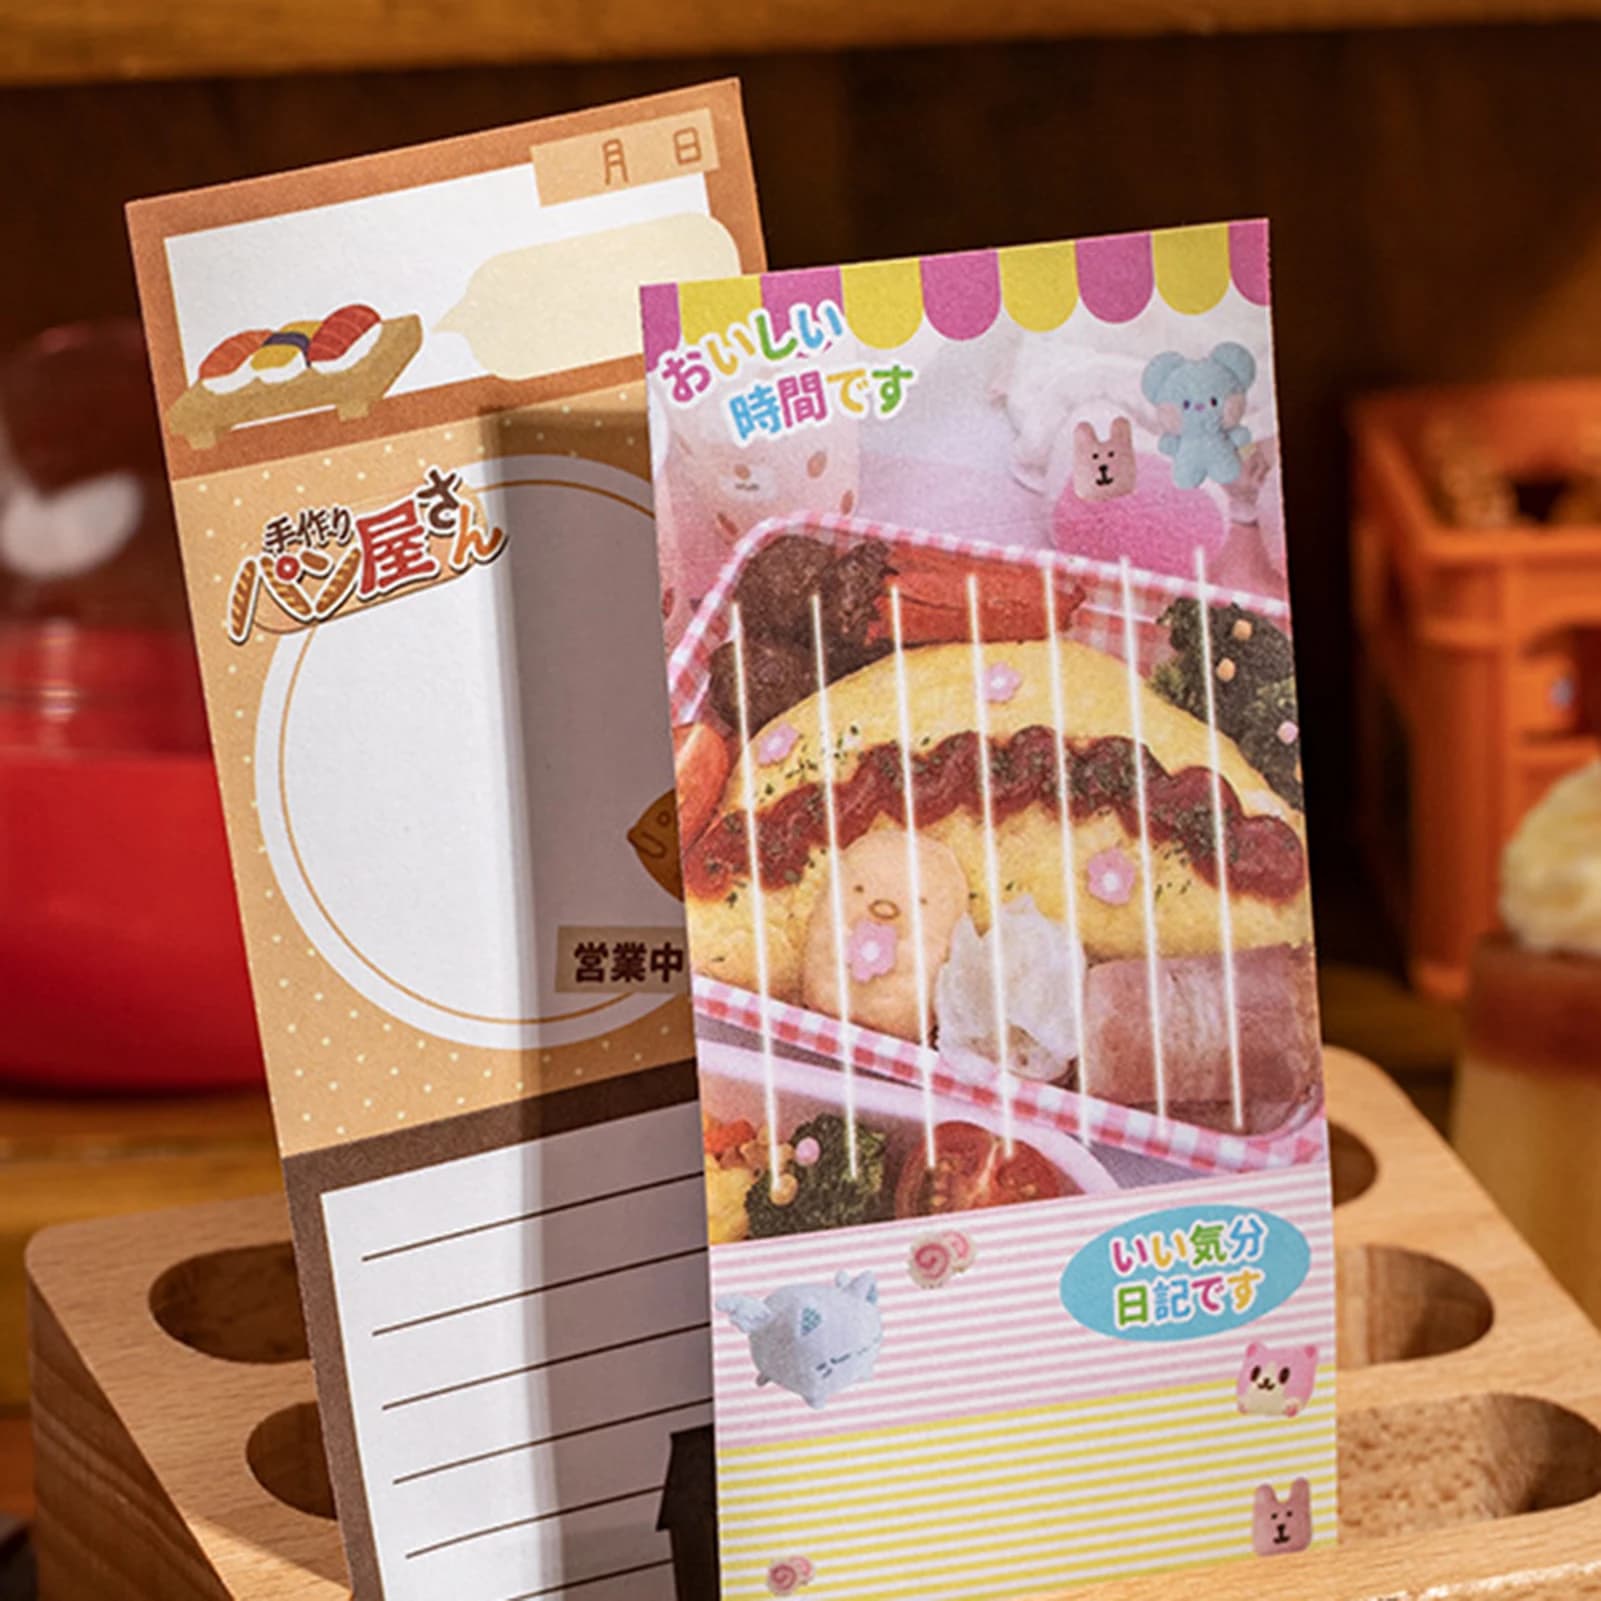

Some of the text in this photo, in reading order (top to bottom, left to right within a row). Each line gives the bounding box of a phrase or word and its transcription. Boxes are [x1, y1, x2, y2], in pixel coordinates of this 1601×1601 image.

[602, 126, 702, 185] 月 日
[661, 305, 843, 402] おいしい
[729, 364, 914, 440] 時間です
[230, 469, 504, 637] パン屋さん
[265, 507, 351, 551] 手作り
[574, 942, 684, 983] 営業中
[1113, 1218, 1266, 1273] いい気分
[1117, 1270, 1261, 1326] 日記です
